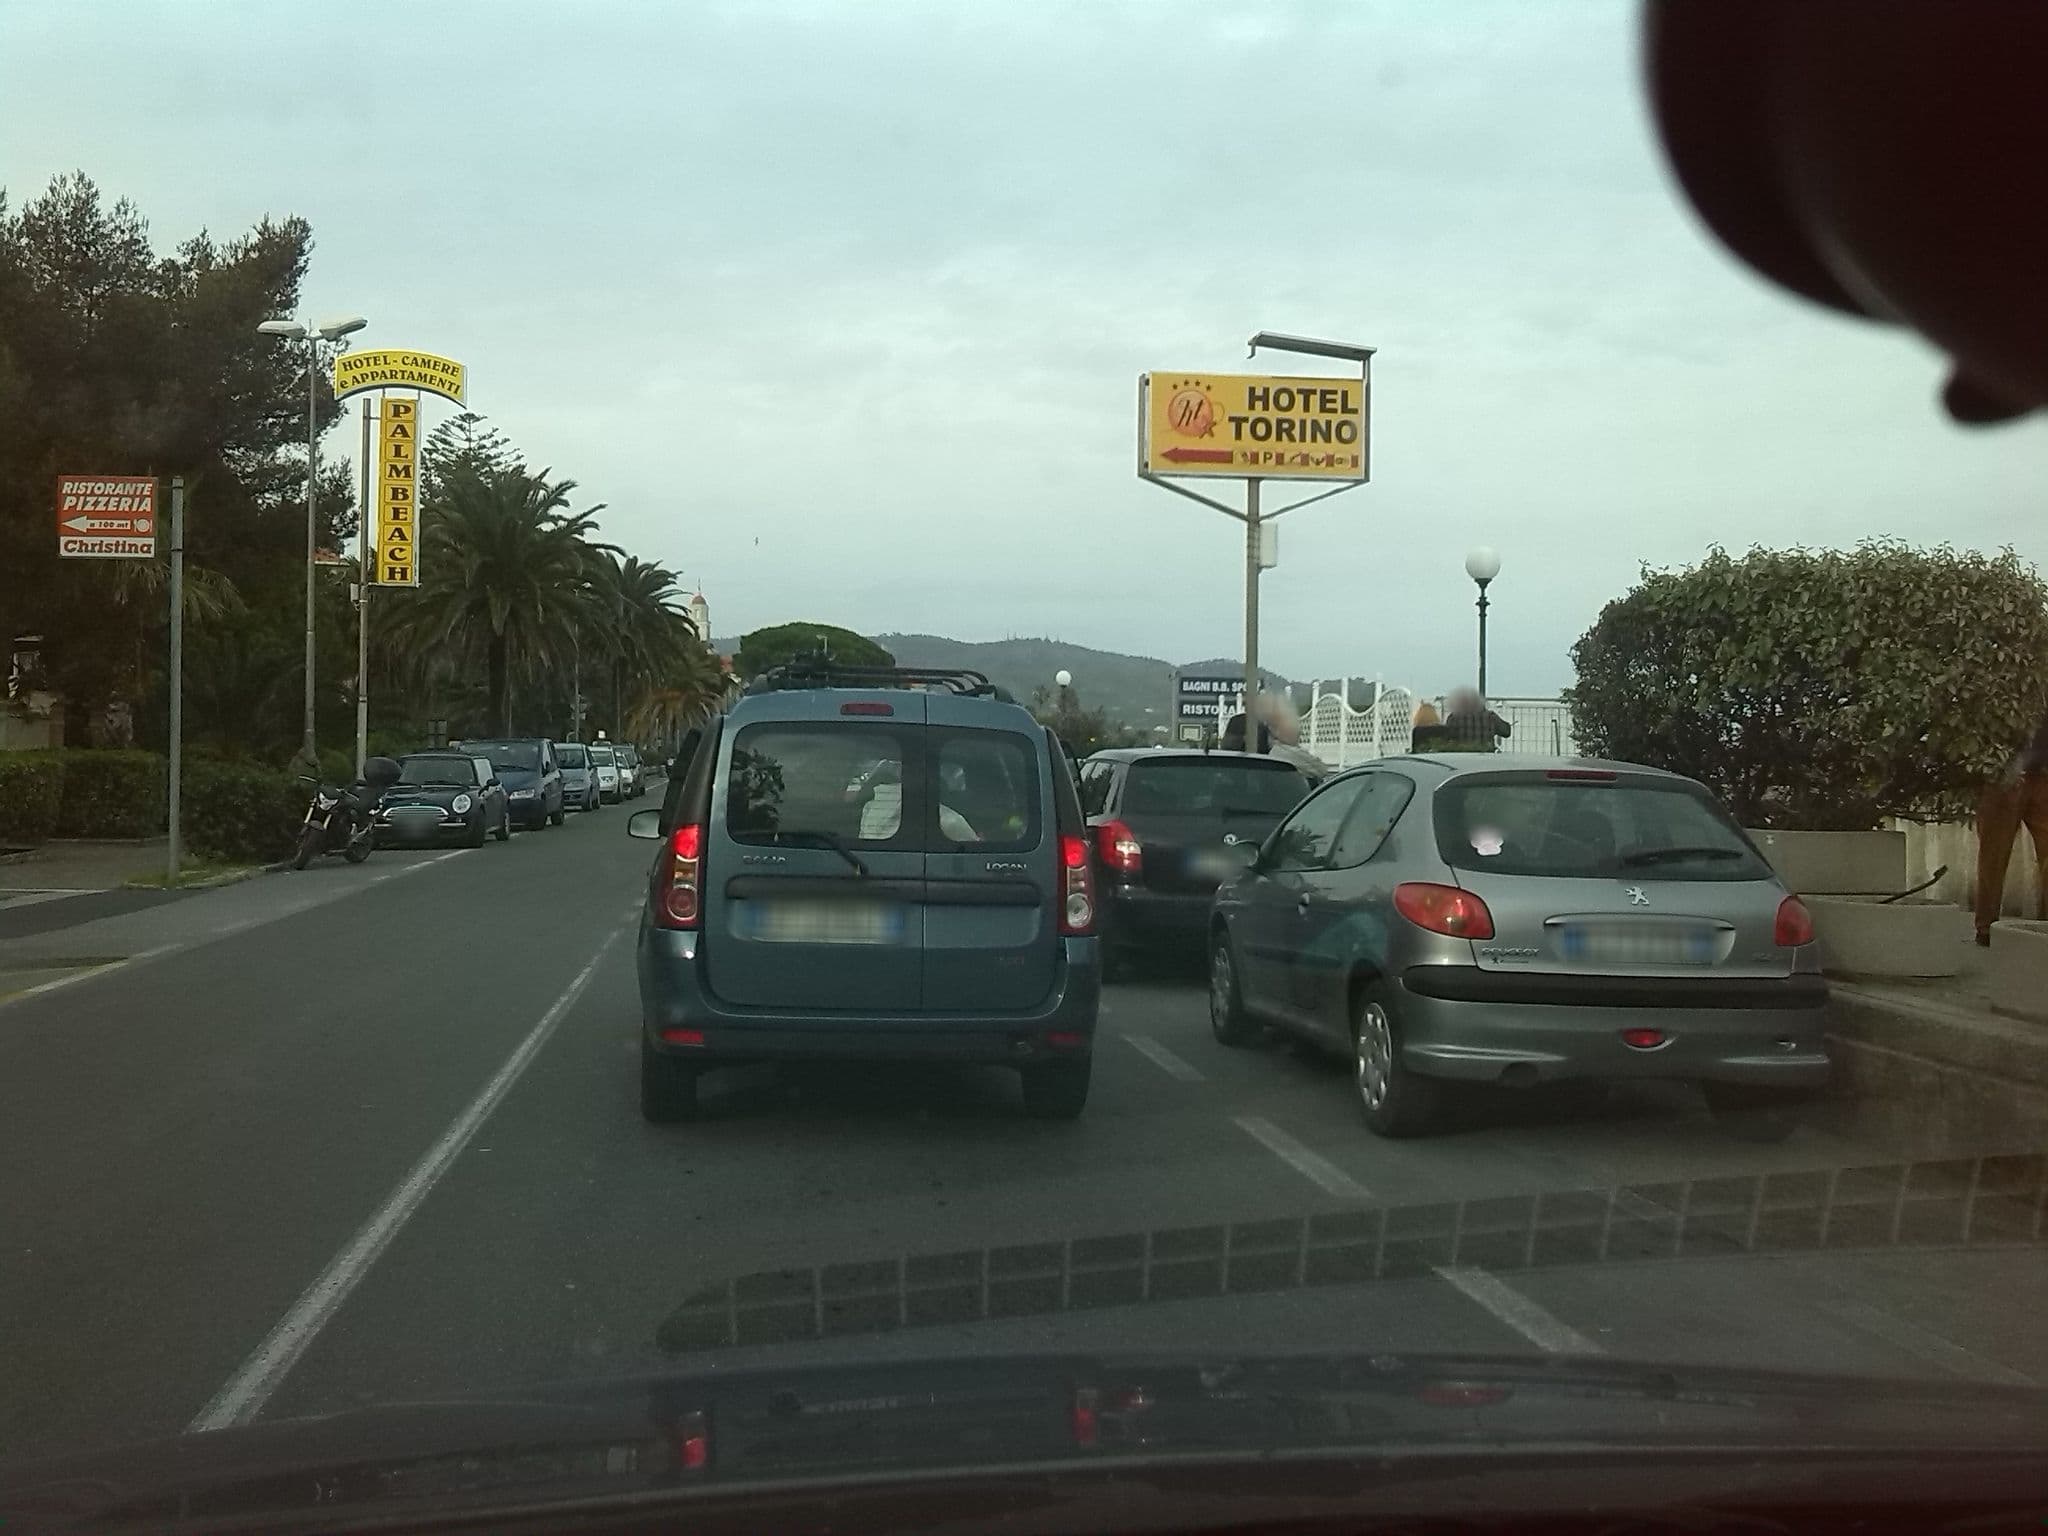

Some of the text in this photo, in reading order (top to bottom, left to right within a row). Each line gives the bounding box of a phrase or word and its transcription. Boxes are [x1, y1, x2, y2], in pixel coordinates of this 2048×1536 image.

[342, 355, 391, 372] HOTEL
[402, 355, 460, 378] CAMERE
[351, 369, 461, 395] APPARTAMENTI
[1248, 386, 1359, 415] HOTEL
[1228, 415, 1358, 445] TORINO
[62, 481, 153, 496] RISTORANTE
[63, 496, 152, 512] PIZZERIA
[63, 540, 153, 554] Christina
[1182, 681, 1211, 692] BAGNI
[986, 862, 1028, 872] LOGAN
